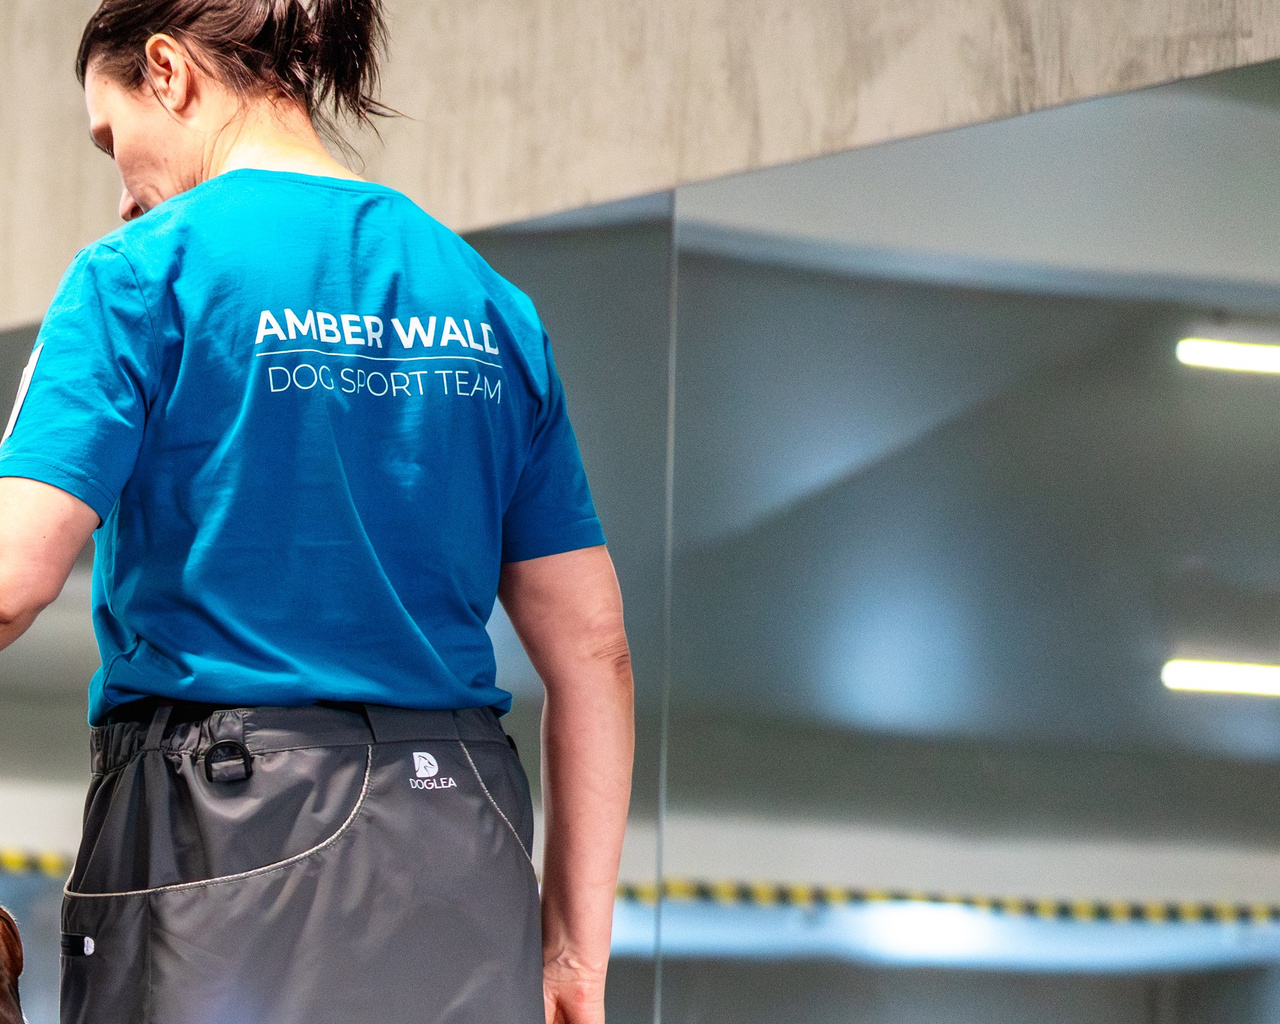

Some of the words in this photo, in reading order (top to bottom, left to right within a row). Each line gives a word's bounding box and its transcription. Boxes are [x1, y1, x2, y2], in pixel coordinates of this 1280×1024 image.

[255, 308, 384, 349] AMBER
[391, 316, 500, 355] WALD
[268, 363, 335, 393] DOG
[340, 368, 428, 397] SPORT
[434, 370, 502, 405] TEAM
[409, 777, 458, 790] DOGLEA
